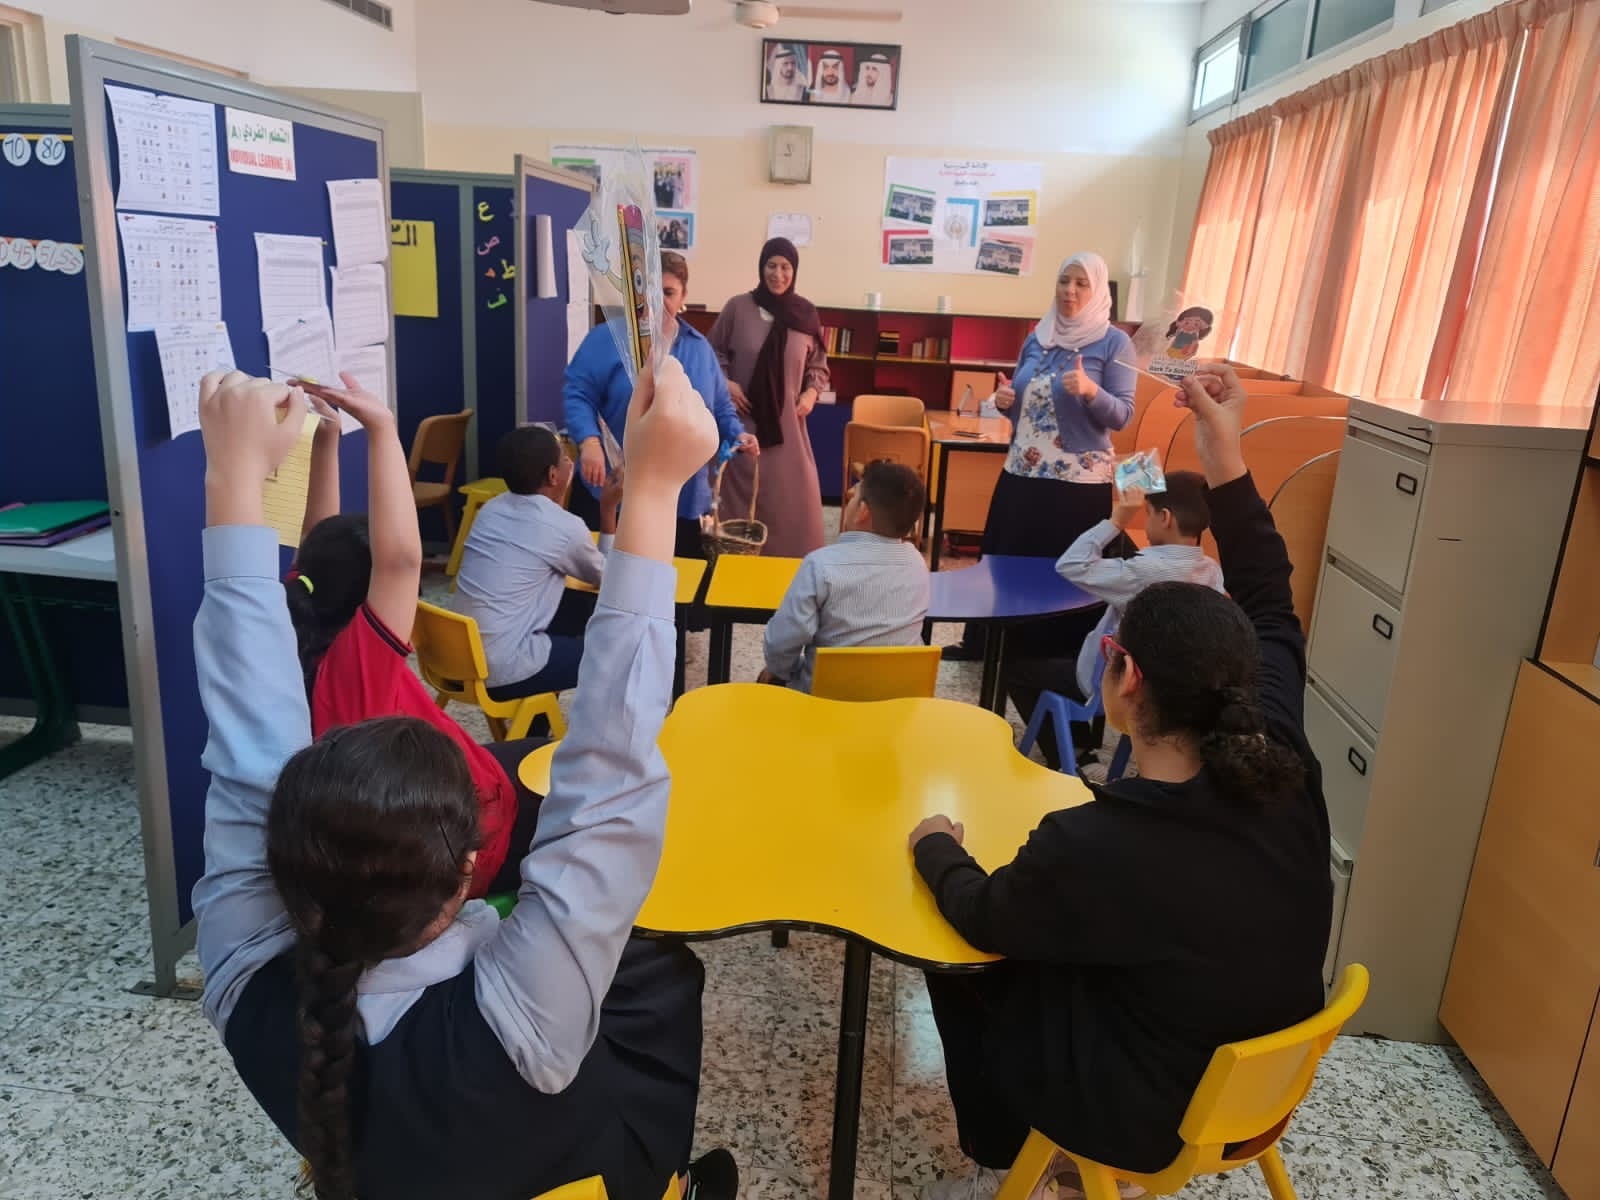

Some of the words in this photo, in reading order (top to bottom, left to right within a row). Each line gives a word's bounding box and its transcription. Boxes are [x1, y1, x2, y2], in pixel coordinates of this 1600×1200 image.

[41, 137, 64, 160] 80
[230, 148, 257, 167] INDIVIDUAL
[258, 152, 284, 171] LEARNING
[477, 201, 495, 222] ع
[12, 243, 34, 268] 45
[477, 236, 500, 256] ص
[1173, 367, 1194, 375] School
